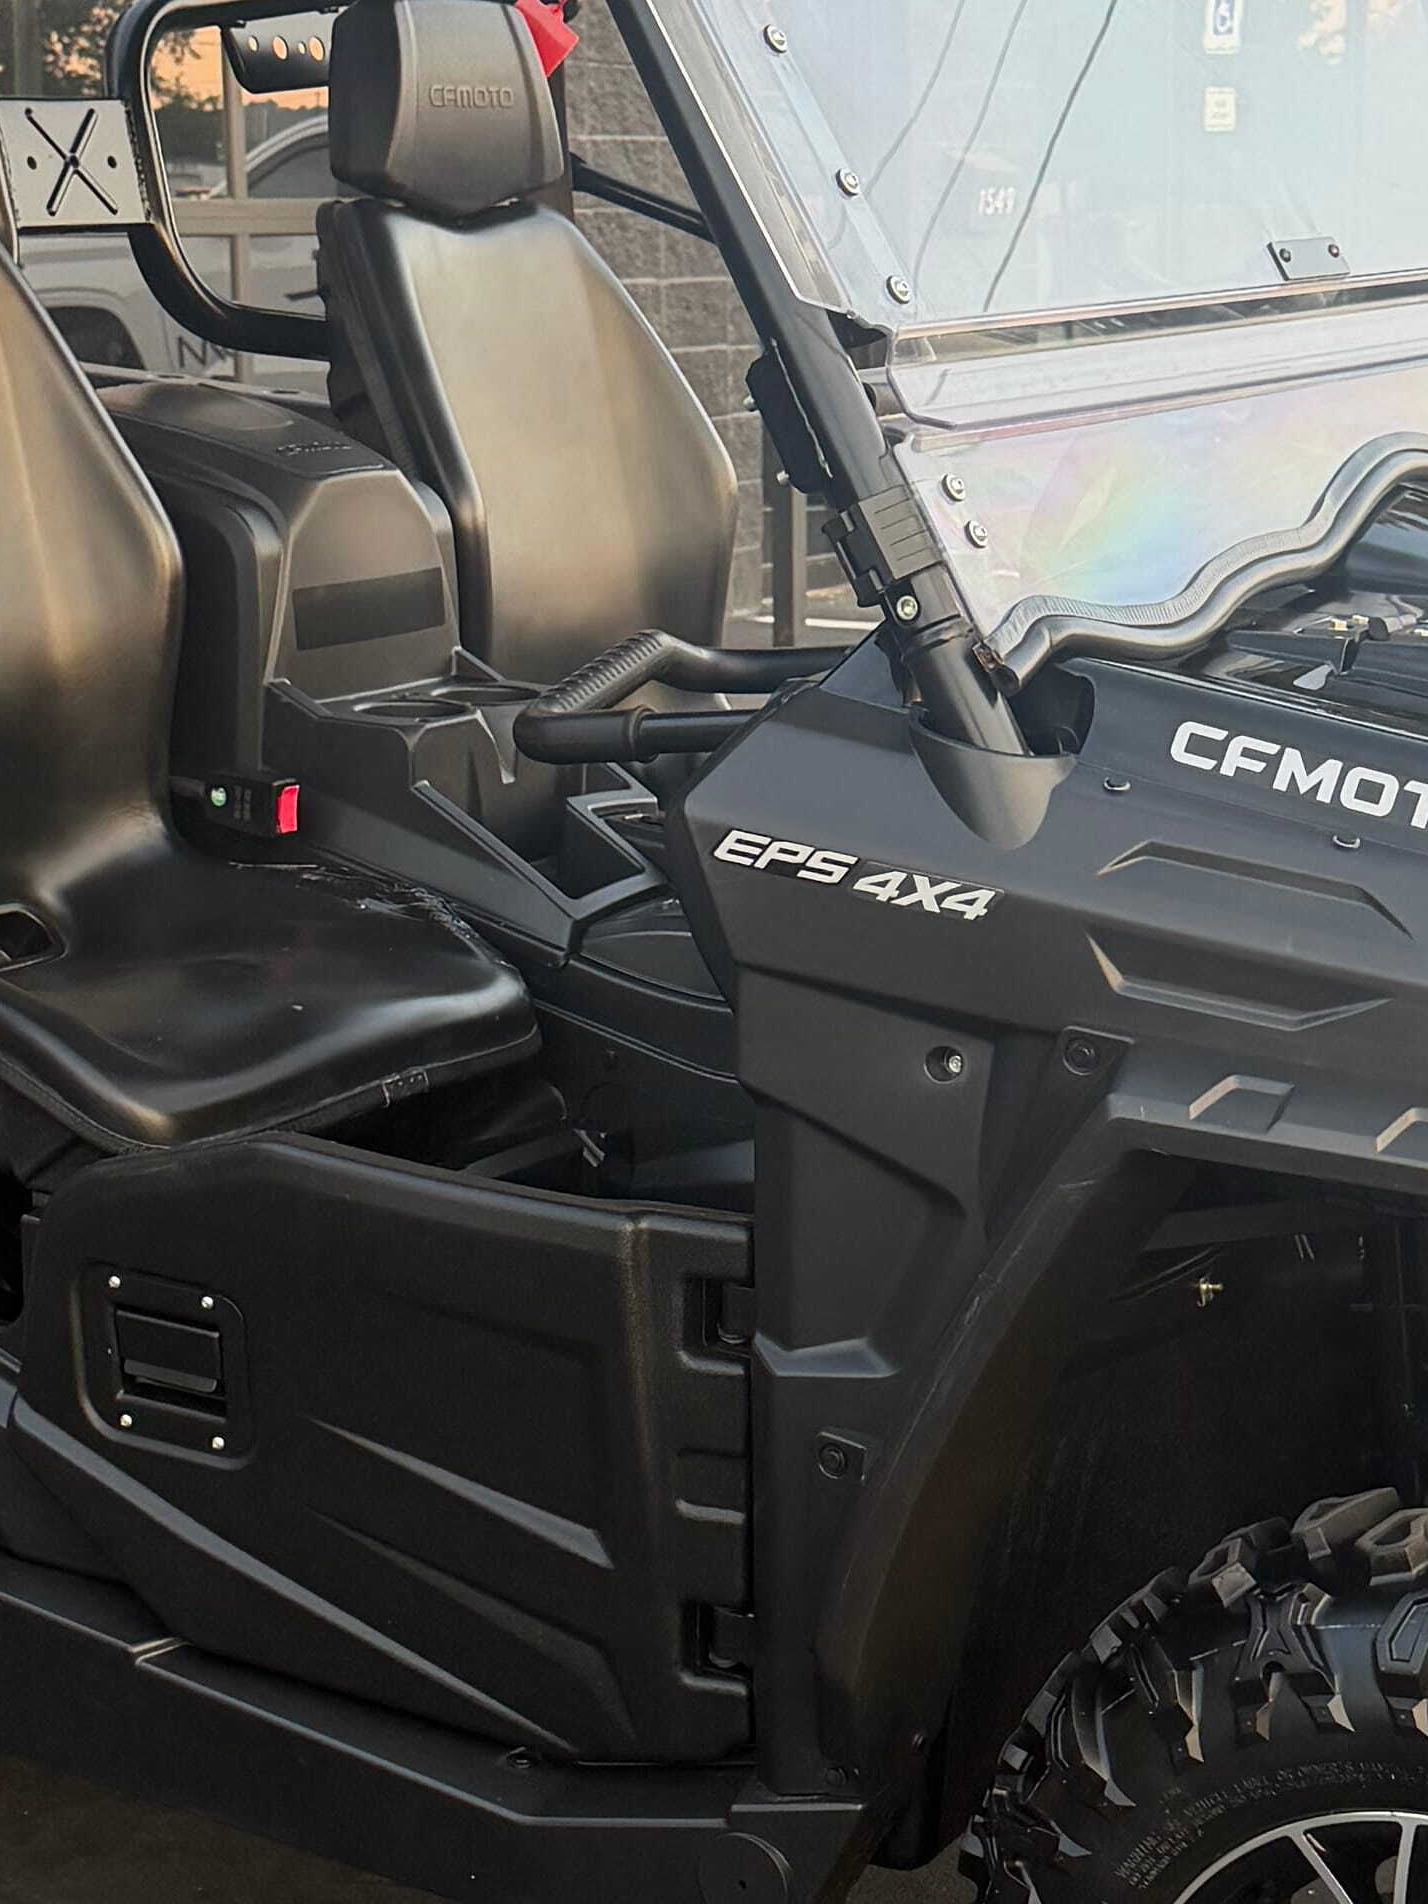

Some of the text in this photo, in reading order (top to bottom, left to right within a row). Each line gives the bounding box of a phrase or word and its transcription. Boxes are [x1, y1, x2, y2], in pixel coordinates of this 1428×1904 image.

[429, 83, 515, 109] CFMOTO
[713, 829, 999, 920] EPS 4X4
